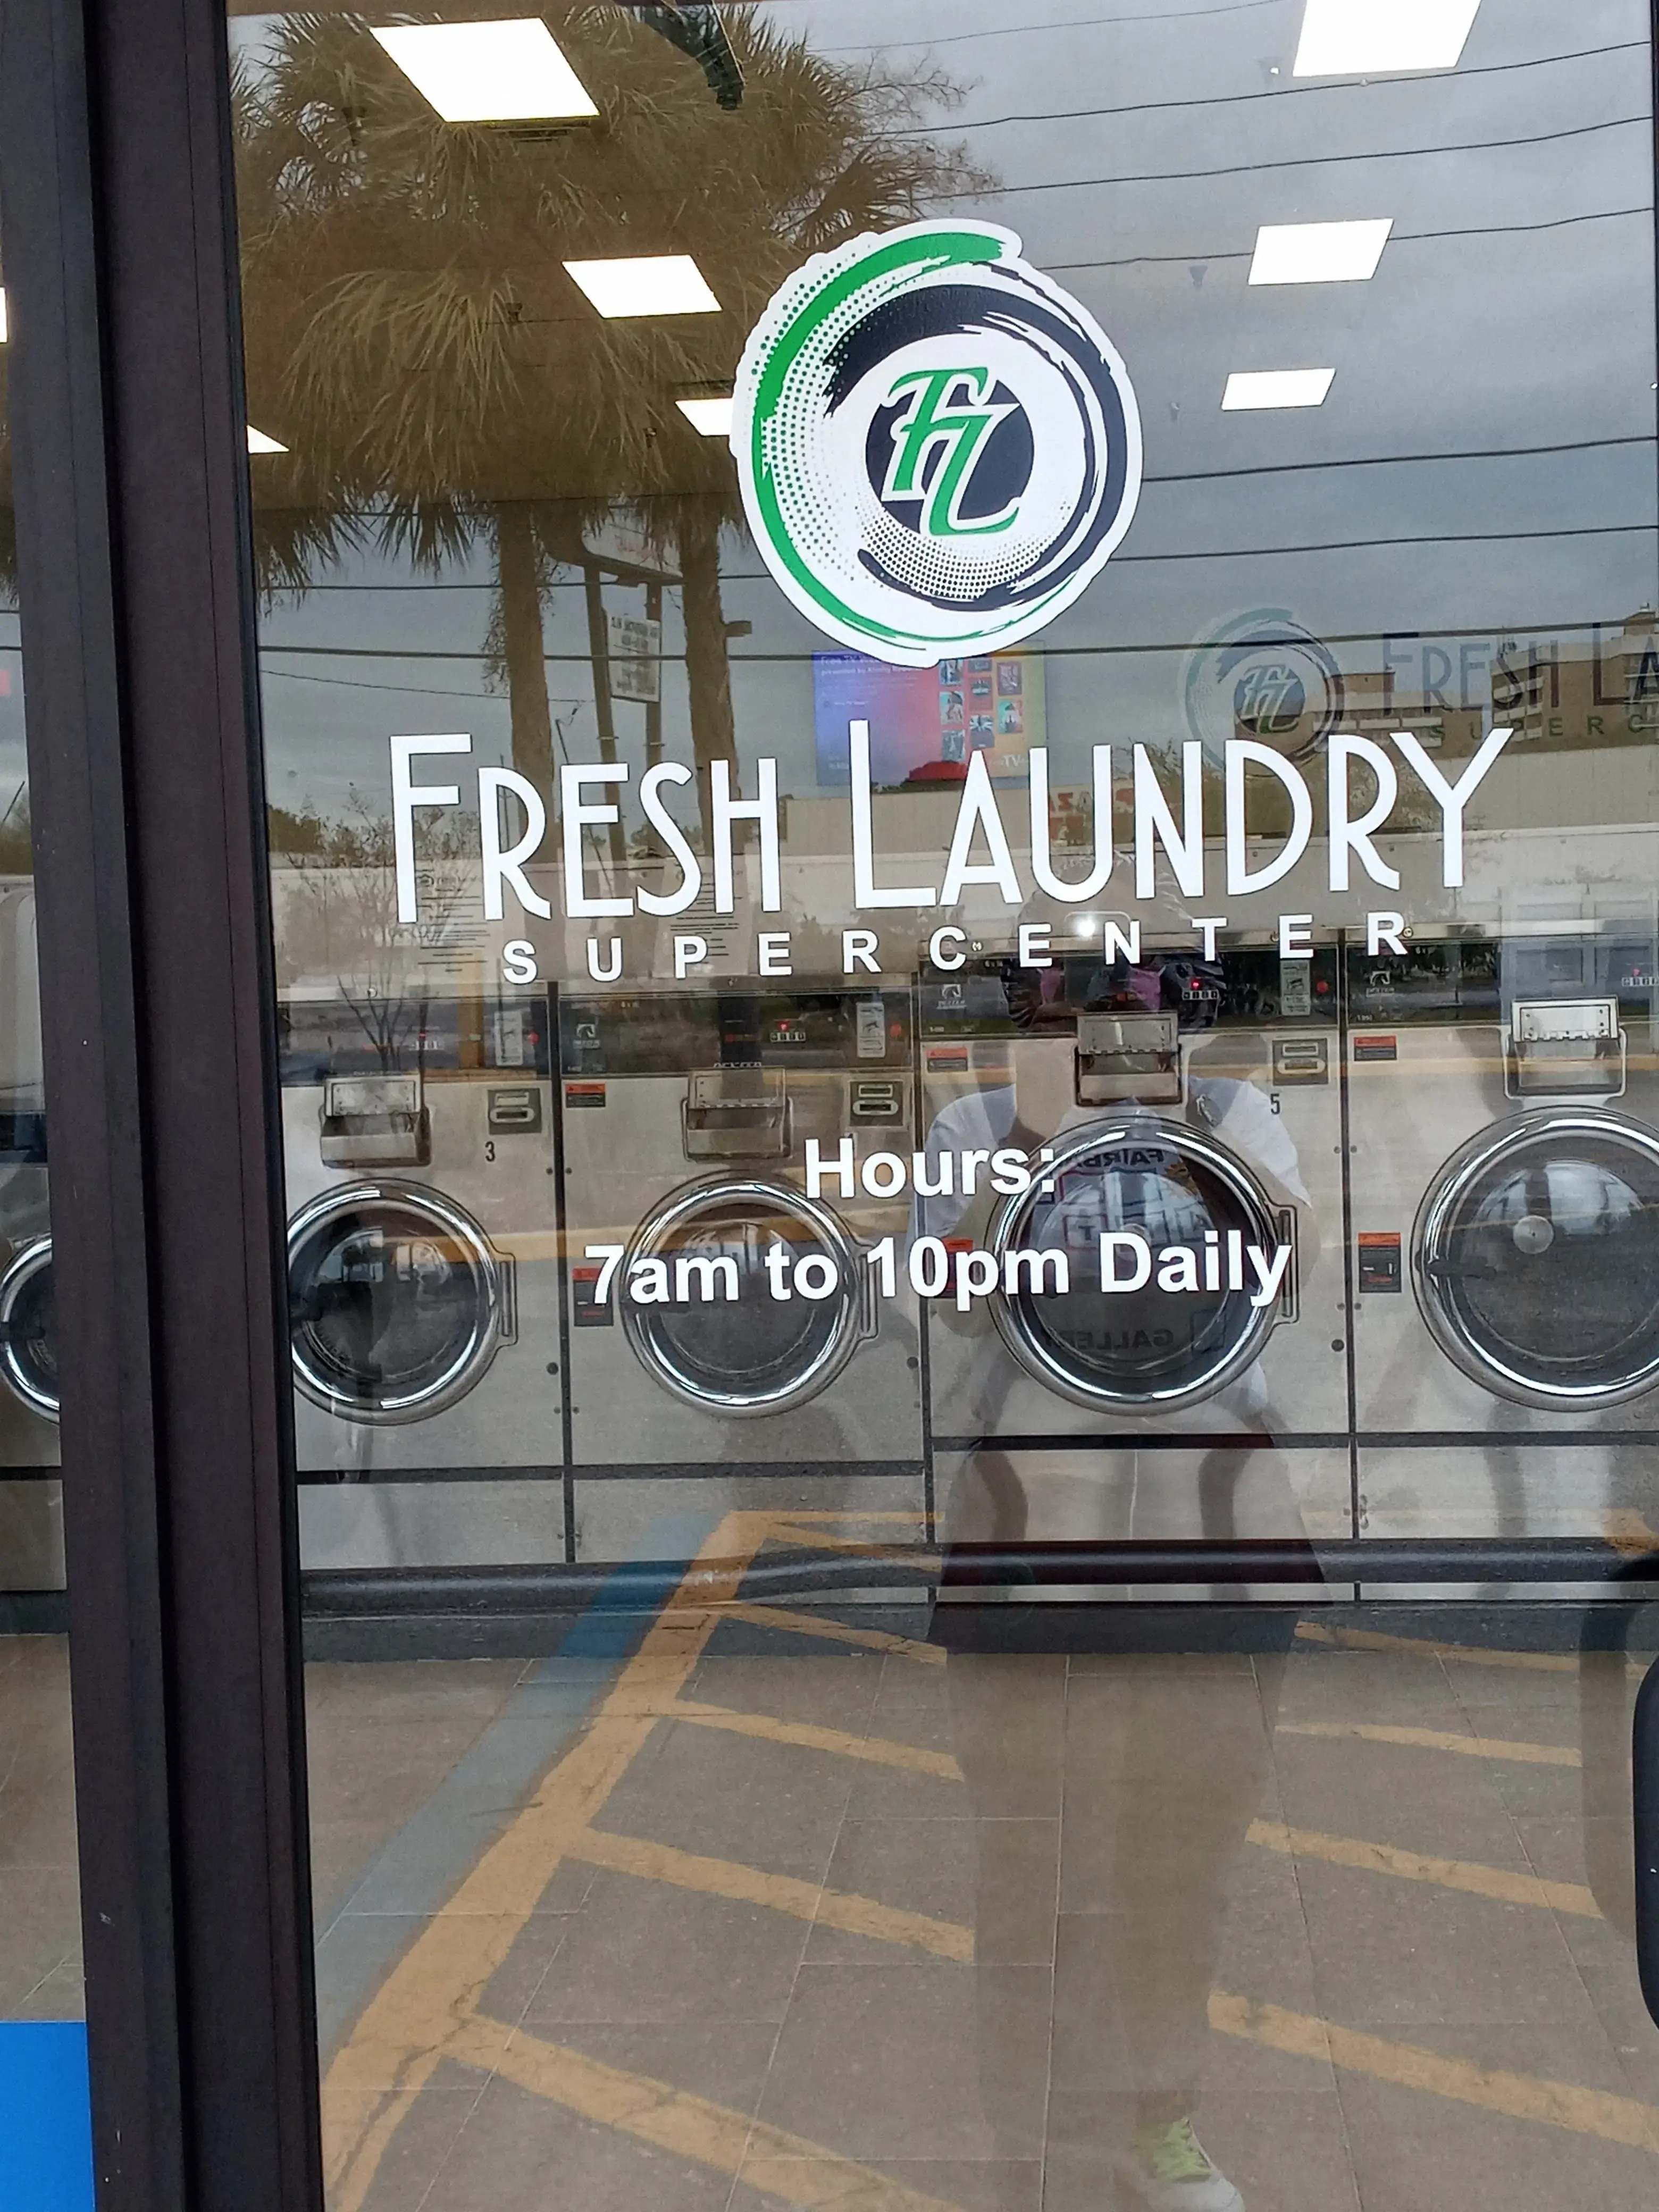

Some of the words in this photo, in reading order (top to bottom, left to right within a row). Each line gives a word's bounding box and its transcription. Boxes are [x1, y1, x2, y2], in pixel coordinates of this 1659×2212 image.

[1382, 631, 1559, 715] FRESH
[390, 733, 781, 923] FRESH
[849, 719, 1514, 909] LAUNDRY
[503, 911, 1408, 984] SUPERCENTER
[1270, 1093, 1280, 1115] 5
[484, 1141, 495, 1162] 3
[805, 1138, 1055, 1199] Hours:
[585, 1245, 739, 1304] 7am
[764, 1242, 838, 1301] to
[867, 1236, 1069, 1311] 10pm
[1100, 1229, 1293, 1308] Daily
